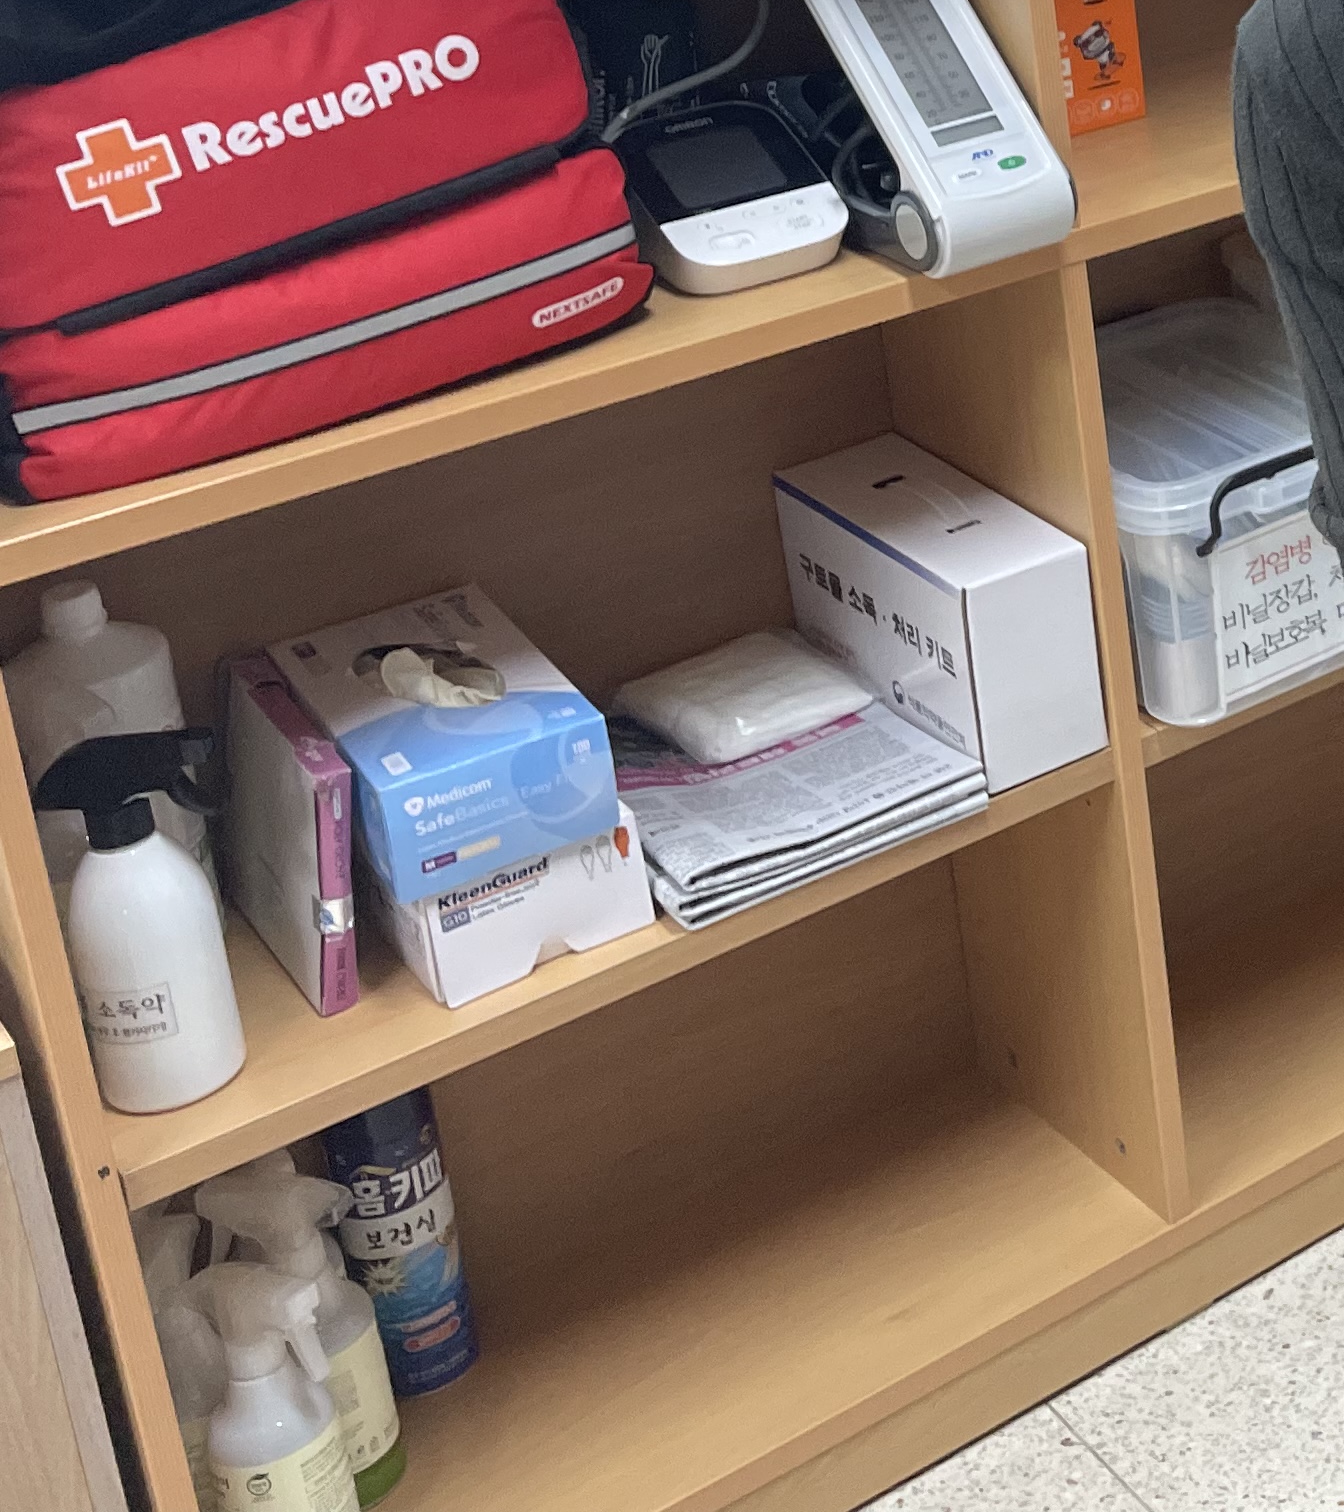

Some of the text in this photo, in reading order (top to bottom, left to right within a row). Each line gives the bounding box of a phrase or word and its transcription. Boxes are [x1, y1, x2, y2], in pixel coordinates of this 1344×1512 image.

[181, 34, 480, 172] RescuePRO
[540, 279, 618, 323] NEXTSAFE
[1245, 534, 1312, 586] 감염병
[848, 586, 878, 626] 소독
[892, 612, 923, 657] 처리
[925, 636, 957, 679] 키트
[427, 778, 493, 809] Medicom
[438, 856, 549, 911] KleenGuard
[97, 993, 165, 1019] 소독약
[353, 1148, 442, 1217] 홈키파
